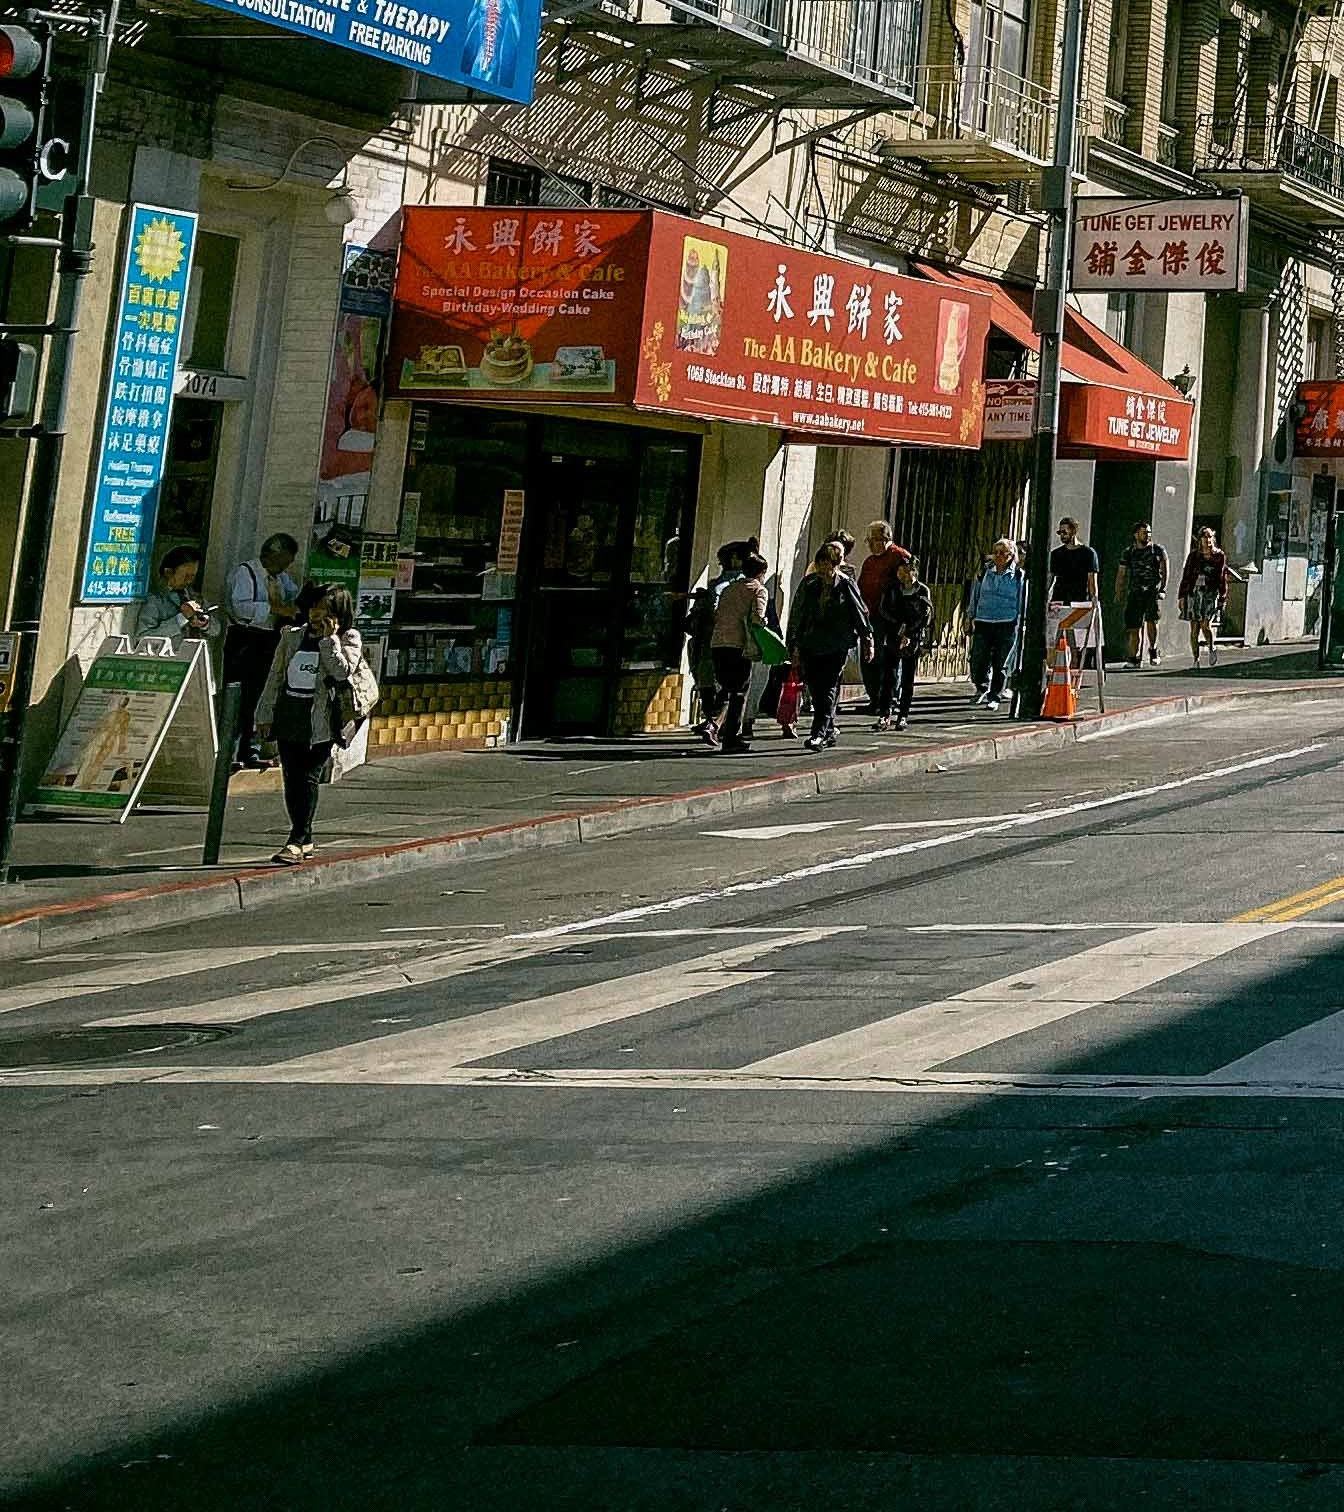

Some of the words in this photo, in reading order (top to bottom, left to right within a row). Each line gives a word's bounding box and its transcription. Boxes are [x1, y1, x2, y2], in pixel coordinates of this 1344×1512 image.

[374, 0, 450, 43] THERAPY
[349, 21, 380, 48] FREE
[381, 33, 432, 66] PARKING
[1080, 215, 1121, 231] TUNE
[1125, 215, 1153, 231] GET
[1158, 214, 1235, 231] JEWELRY
[445, 218, 601, 257] 永興餅家
[582, 263, 625, 281] Cafe
[422, 286, 471, 297] Special
[473, 287, 516, 299] Design
[519, 288, 578, 300] Occasion
[582, 289, 614, 300] Cake
[443, 302, 555, 317] Birthday-Wedding
[558, 304, 591, 316] Cake
[766, 264, 903, 345] 永興餅家
[744, 338, 767, 359] The
[770, 334, 796, 364] AA
[801, 338, 863, 382] Bakery
[864, 352, 880, 378] &
[881, 355, 918, 384] Cafe
[185, 374, 217, 397] 1074
[705, 368, 735, 389] Stockton
[986, 397, 1001, 406] NO
[792, 411, 865, 433] www.aabakery.net
[987, 413, 1006, 422] ANY
[1009, 413, 1030, 422] TIME
[1108, 417, 1128, 436] TUNE
[1131, 421, 1145, 439] GET
[1146, 424, 1180, 445] JEWELRY
[109, 526, 136, 542] FREE
